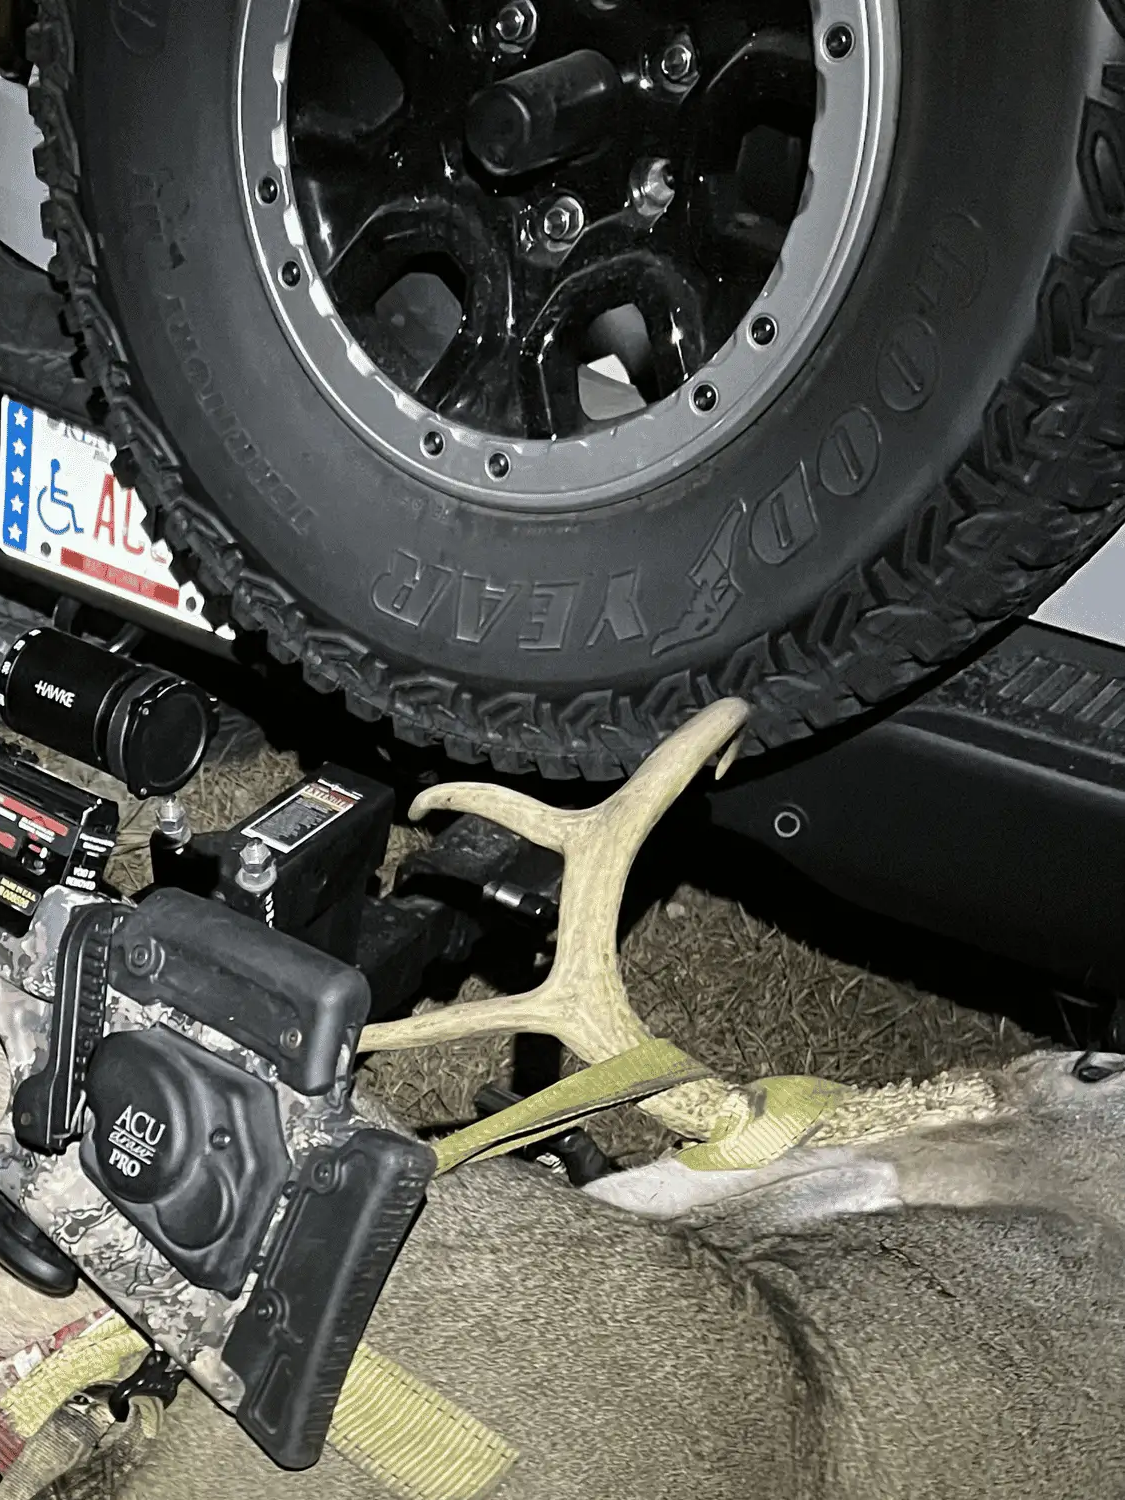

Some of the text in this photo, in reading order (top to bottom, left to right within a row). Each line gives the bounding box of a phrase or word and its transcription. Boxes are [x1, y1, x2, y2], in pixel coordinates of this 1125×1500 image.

[35, 680, 75, 708] HAWKE
[115, 1104, 166, 1146] ACU
[109, 1131, 154, 1157] draw
[108, 1148, 141, 1177] PRO
